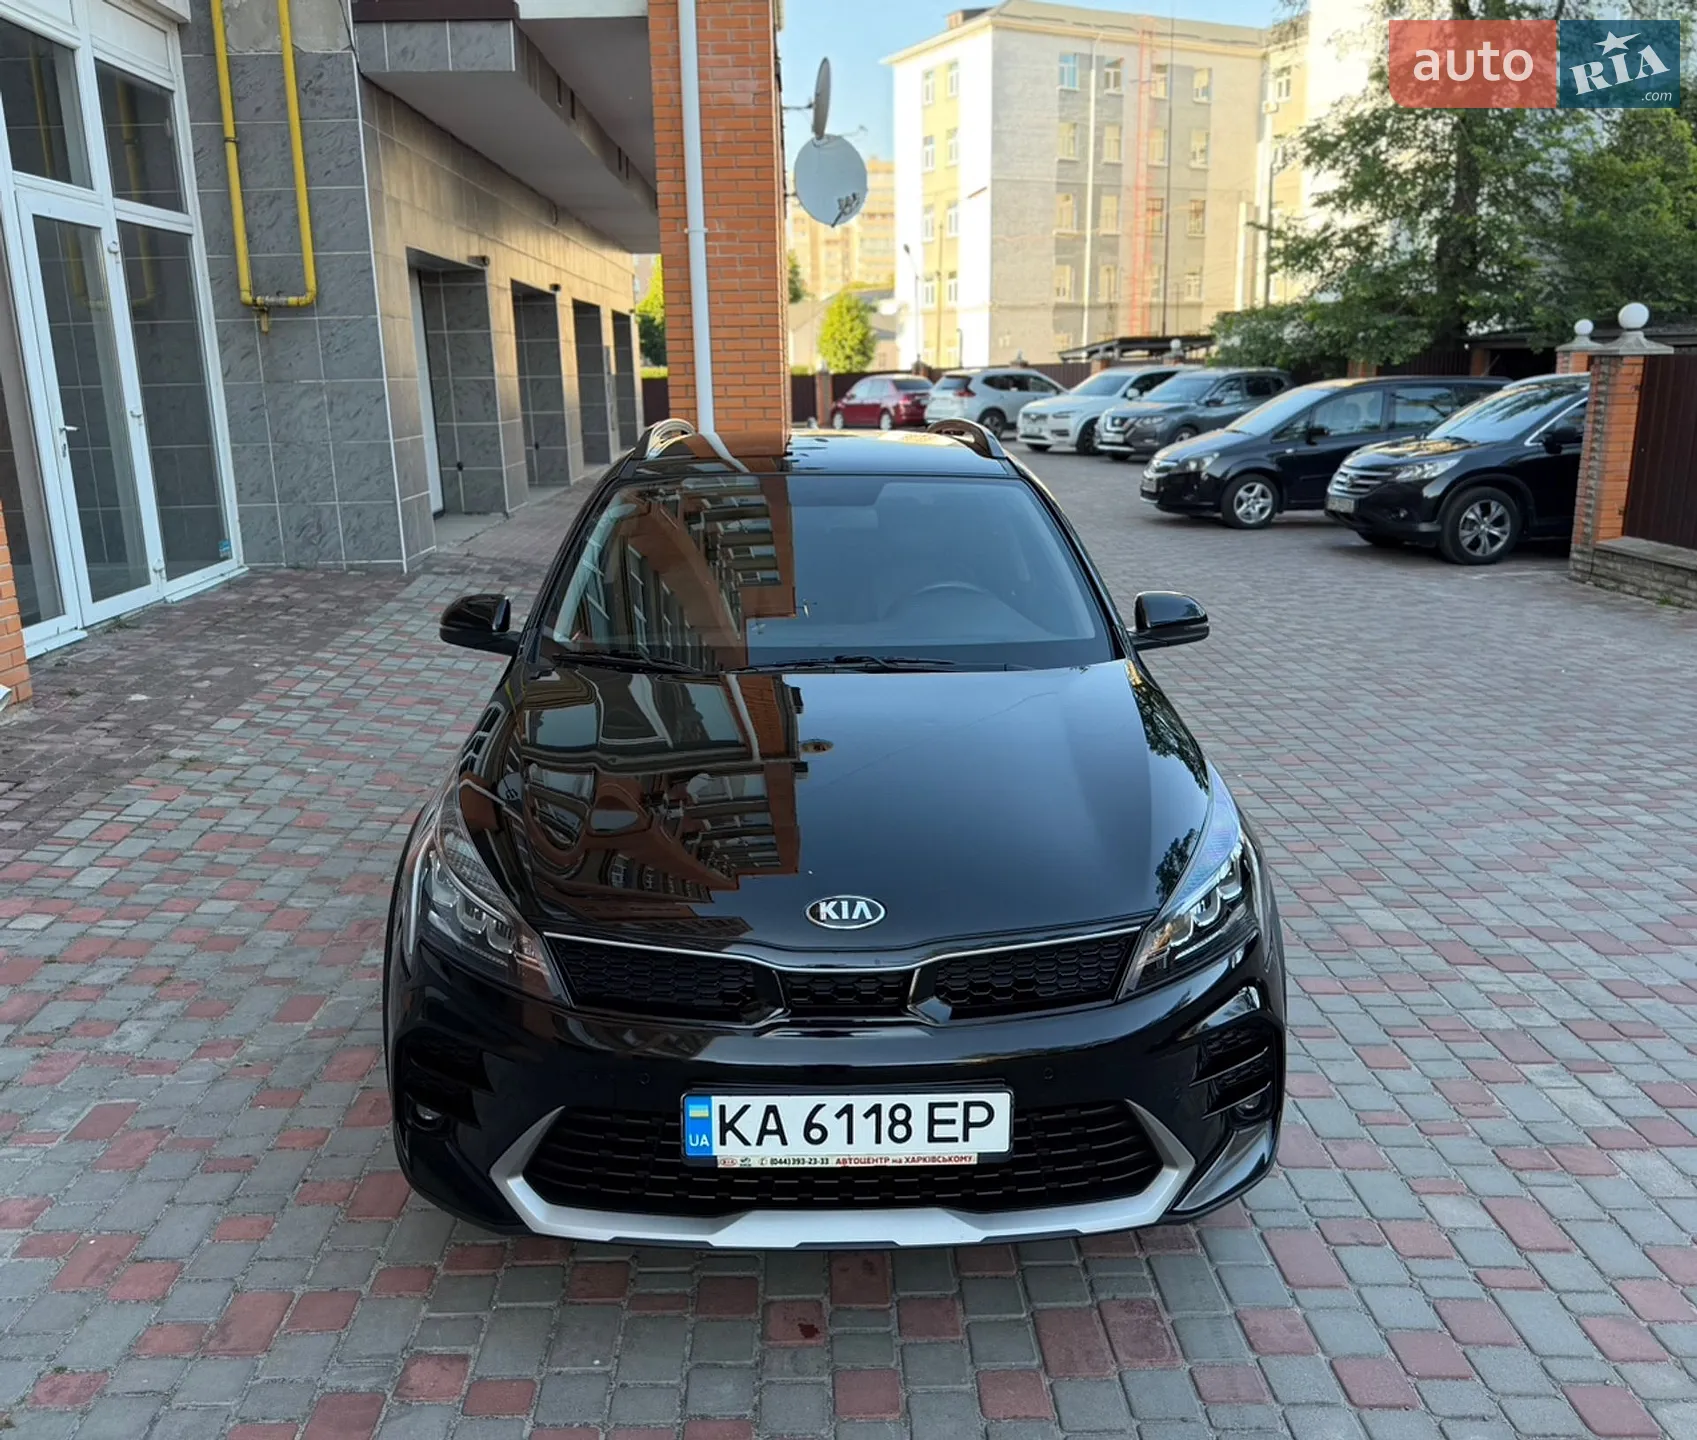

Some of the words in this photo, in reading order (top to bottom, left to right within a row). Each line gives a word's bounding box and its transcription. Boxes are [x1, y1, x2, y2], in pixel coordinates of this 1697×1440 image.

[819, 901, 873, 920] KIA
[719, 1103, 789, 1147] KA
[803, 1102, 913, 1146] 6118
[927, 1100, 995, 1144] EP
[689, 1133, 710, 1147] UA
[835, 1157, 890, 1166] АВТОЦЕНТР
[904, 1155, 973, 1164] ХАРКІВСЬКОМУ
